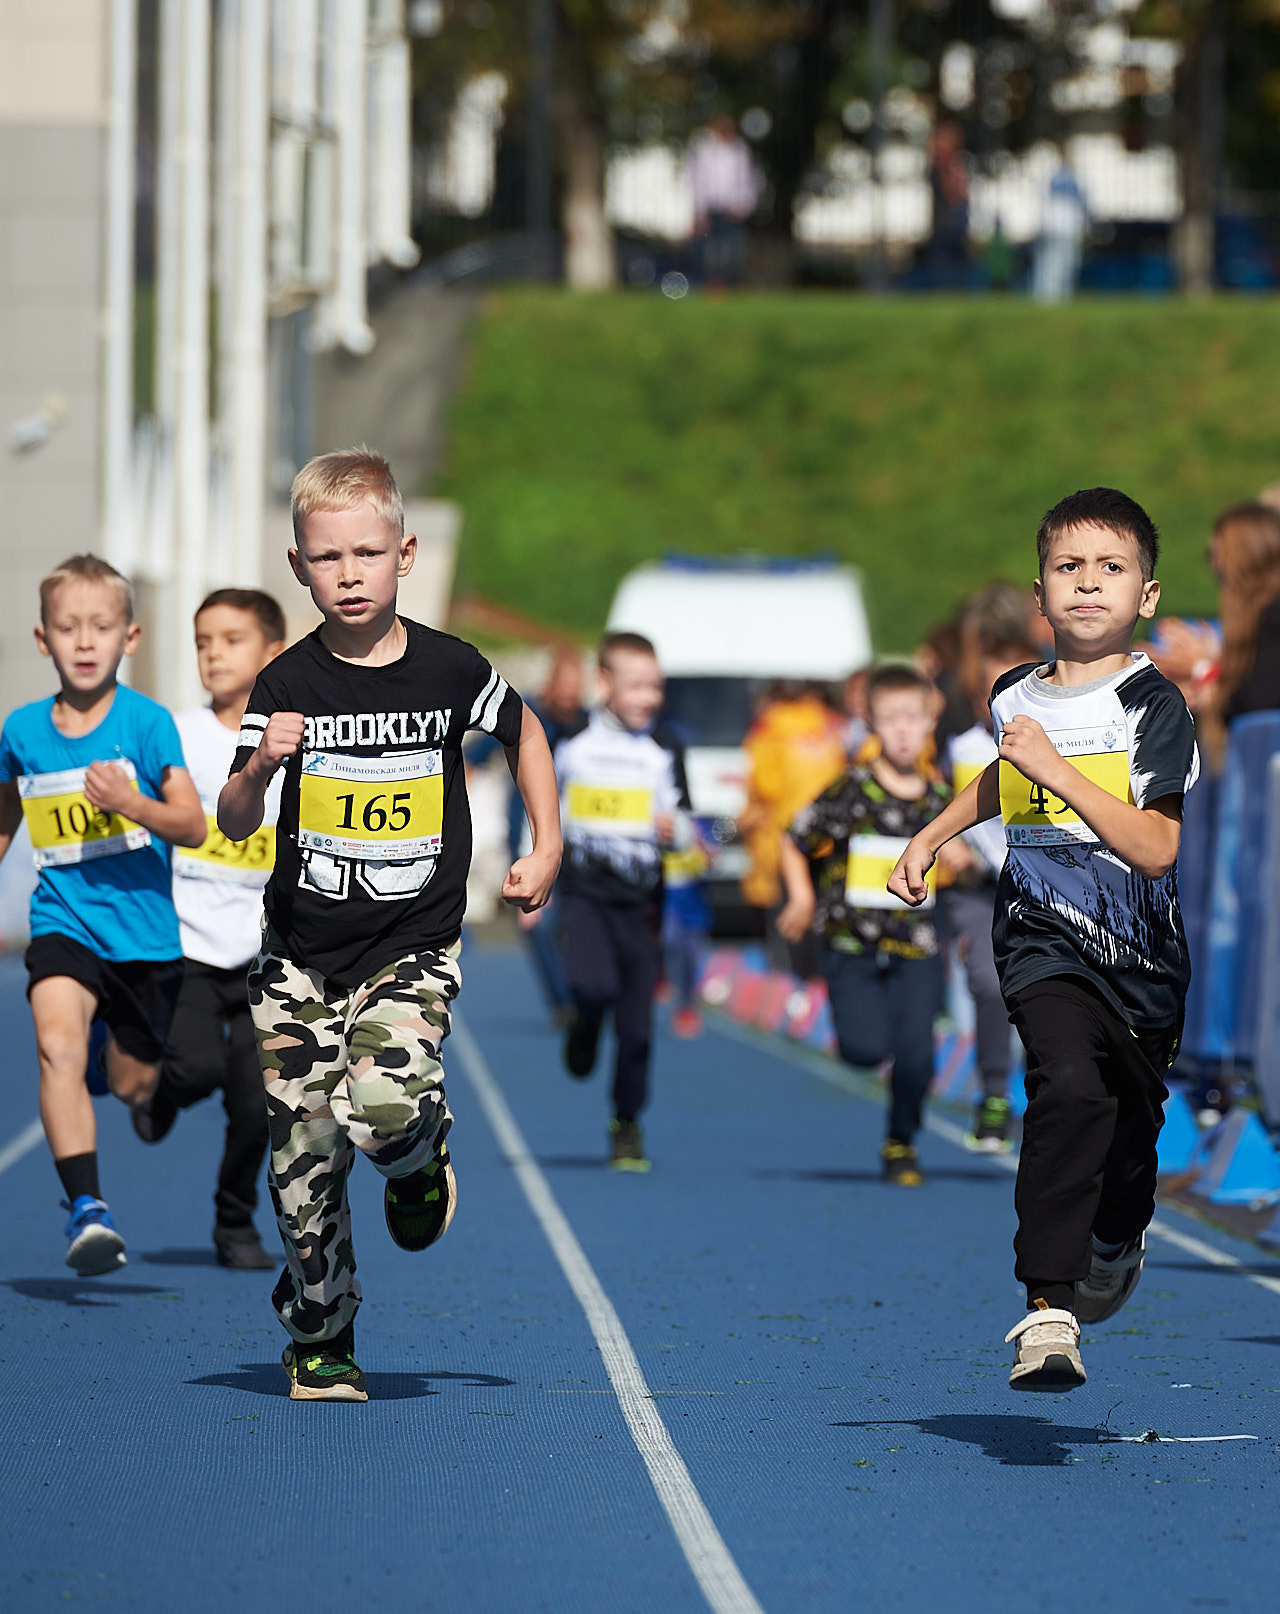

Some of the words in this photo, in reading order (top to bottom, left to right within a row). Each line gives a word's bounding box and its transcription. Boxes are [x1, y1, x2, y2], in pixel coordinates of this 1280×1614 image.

[303, 709, 451, 749] BROOKLYN
[331, 763, 397, 776] Динамовская
[399, 764, 420, 773] миля
[336, 792, 411, 832] 165
